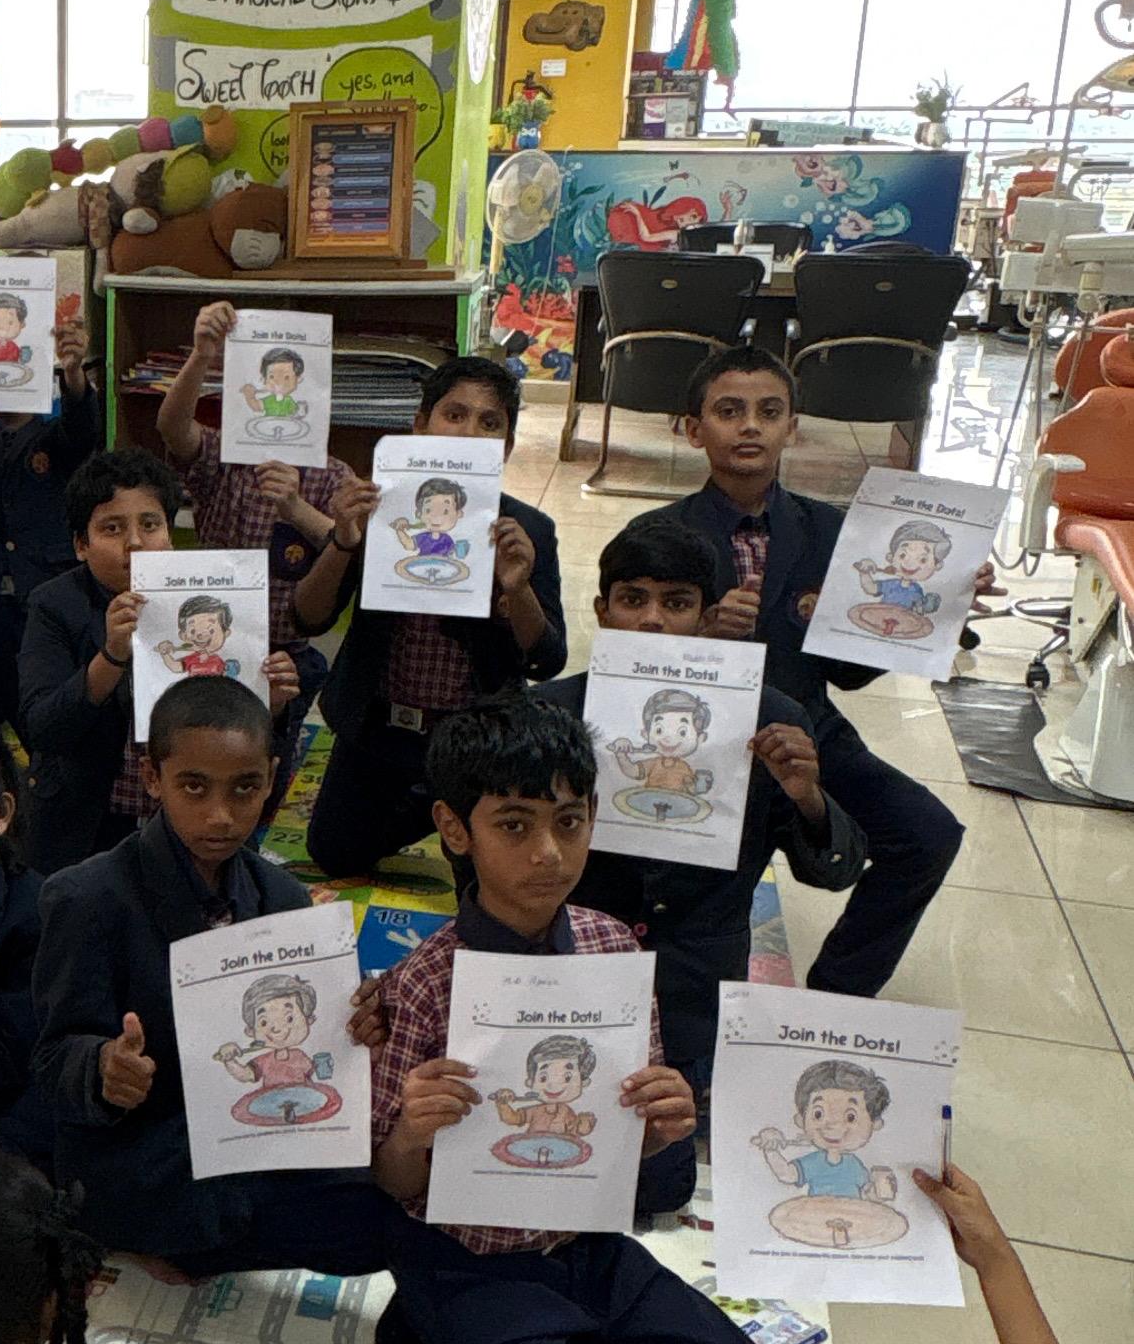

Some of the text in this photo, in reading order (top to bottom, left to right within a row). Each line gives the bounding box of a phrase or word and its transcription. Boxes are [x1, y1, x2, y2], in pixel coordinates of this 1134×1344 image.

[382, 71, 414, 86] and
[407, 458, 472, 471] Join the Dots!
[164, 576, 234, 587] Join the Dots!
[632, 662, 718, 682] Join the Dots!
[272, 831, 304, 845] 22
[374, 909, 411, 927] 18
[220, 944, 315, 972] Join the Dots!
[516, 1010, 601, 1024] Join the Dots!
[778, 1025, 901, 1054] Join the Dots!
